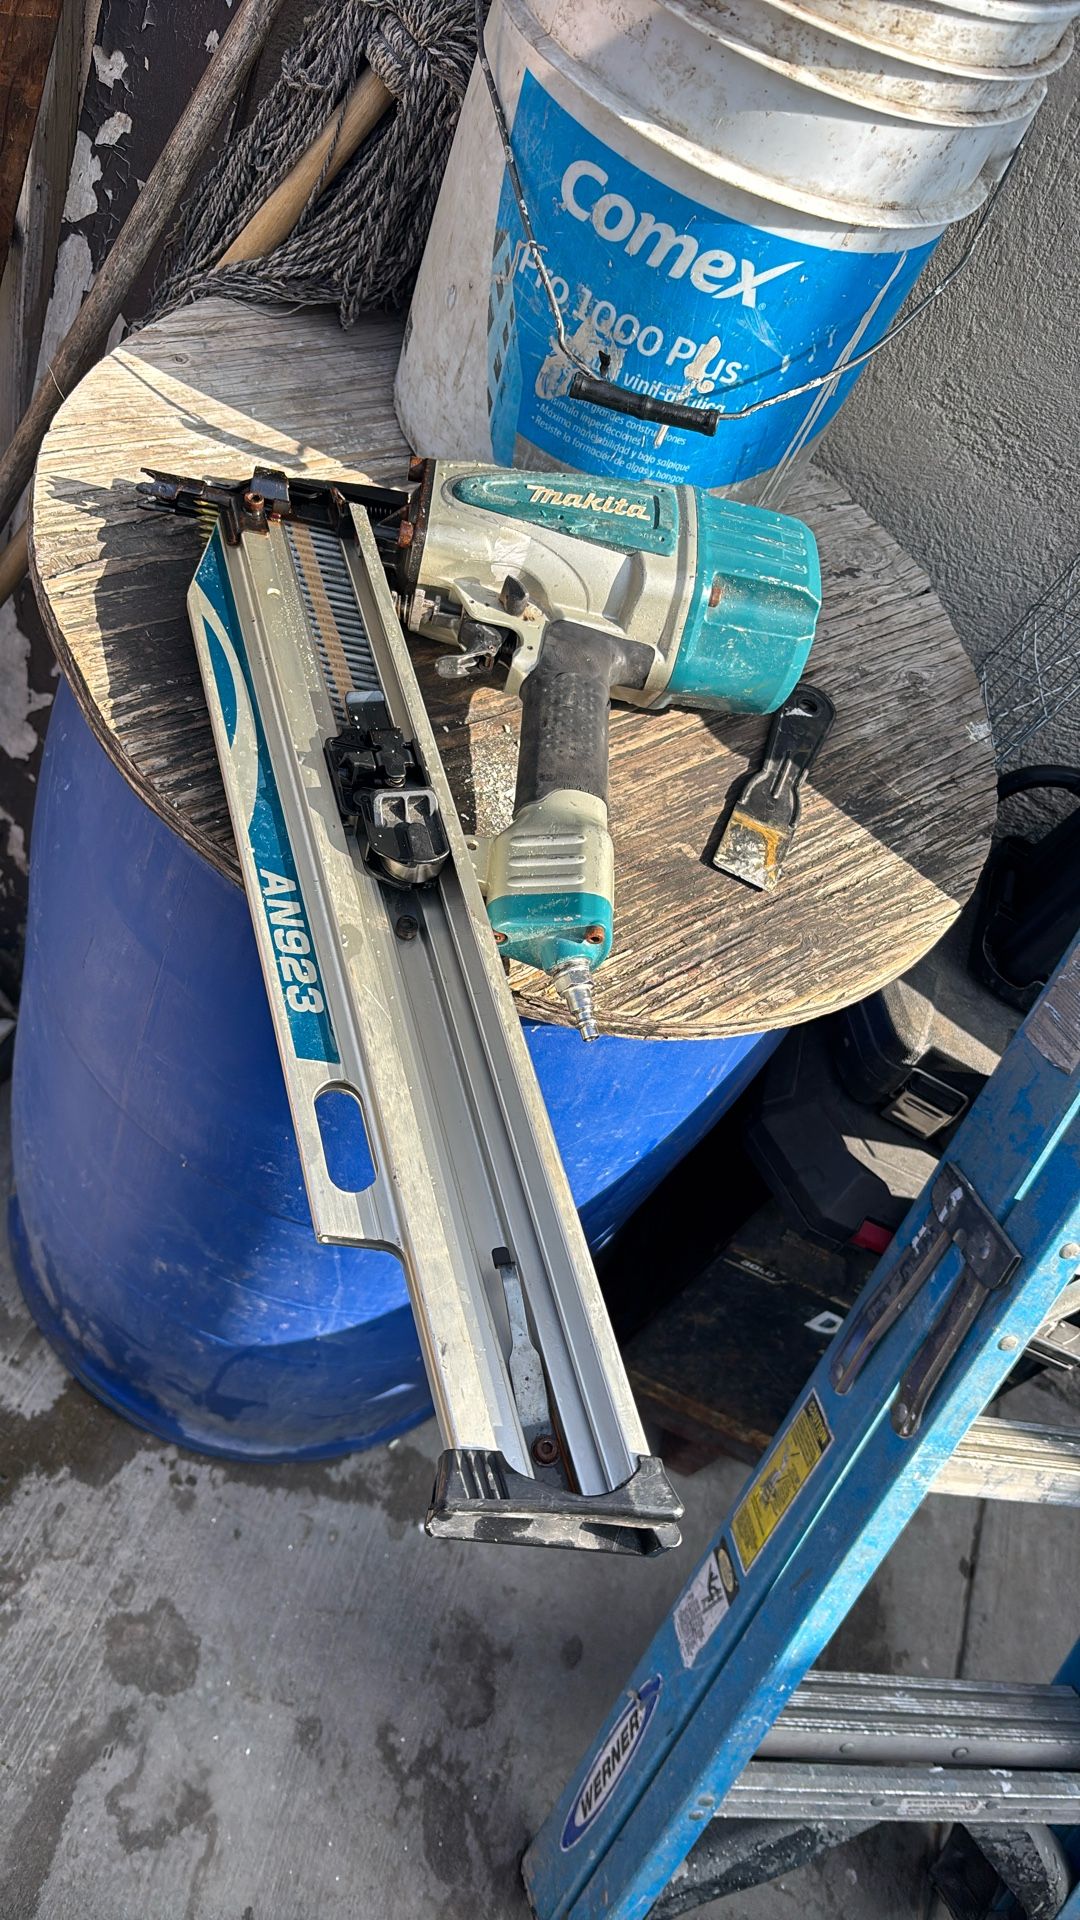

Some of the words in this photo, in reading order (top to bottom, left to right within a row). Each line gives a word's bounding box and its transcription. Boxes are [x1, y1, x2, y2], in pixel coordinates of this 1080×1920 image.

[561, 160, 805, 308] Comex
[571, 282, 664, 357] 1000
[535, 415, 562, 437] Resiste
[563, 431, 571, 443] la
[571, 436, 613, 462] formación
[613, 452, 625, 467] de
[625, 458, 648, 476] algas
[540, 403, 571, 428] Máxima
[638, 449, 657, 467] bajo
[656, 456, 691, 473] salpique
[550, 397, 579, 418] isimula
[580, 413, 641, 446] imperfecciones
[590, 402, 624, 425] grandes
[626, 419, 688, 446] construiones
[260, 868, 325, 1014] AN923
[580, 1709, 641, 1819] WERNER
